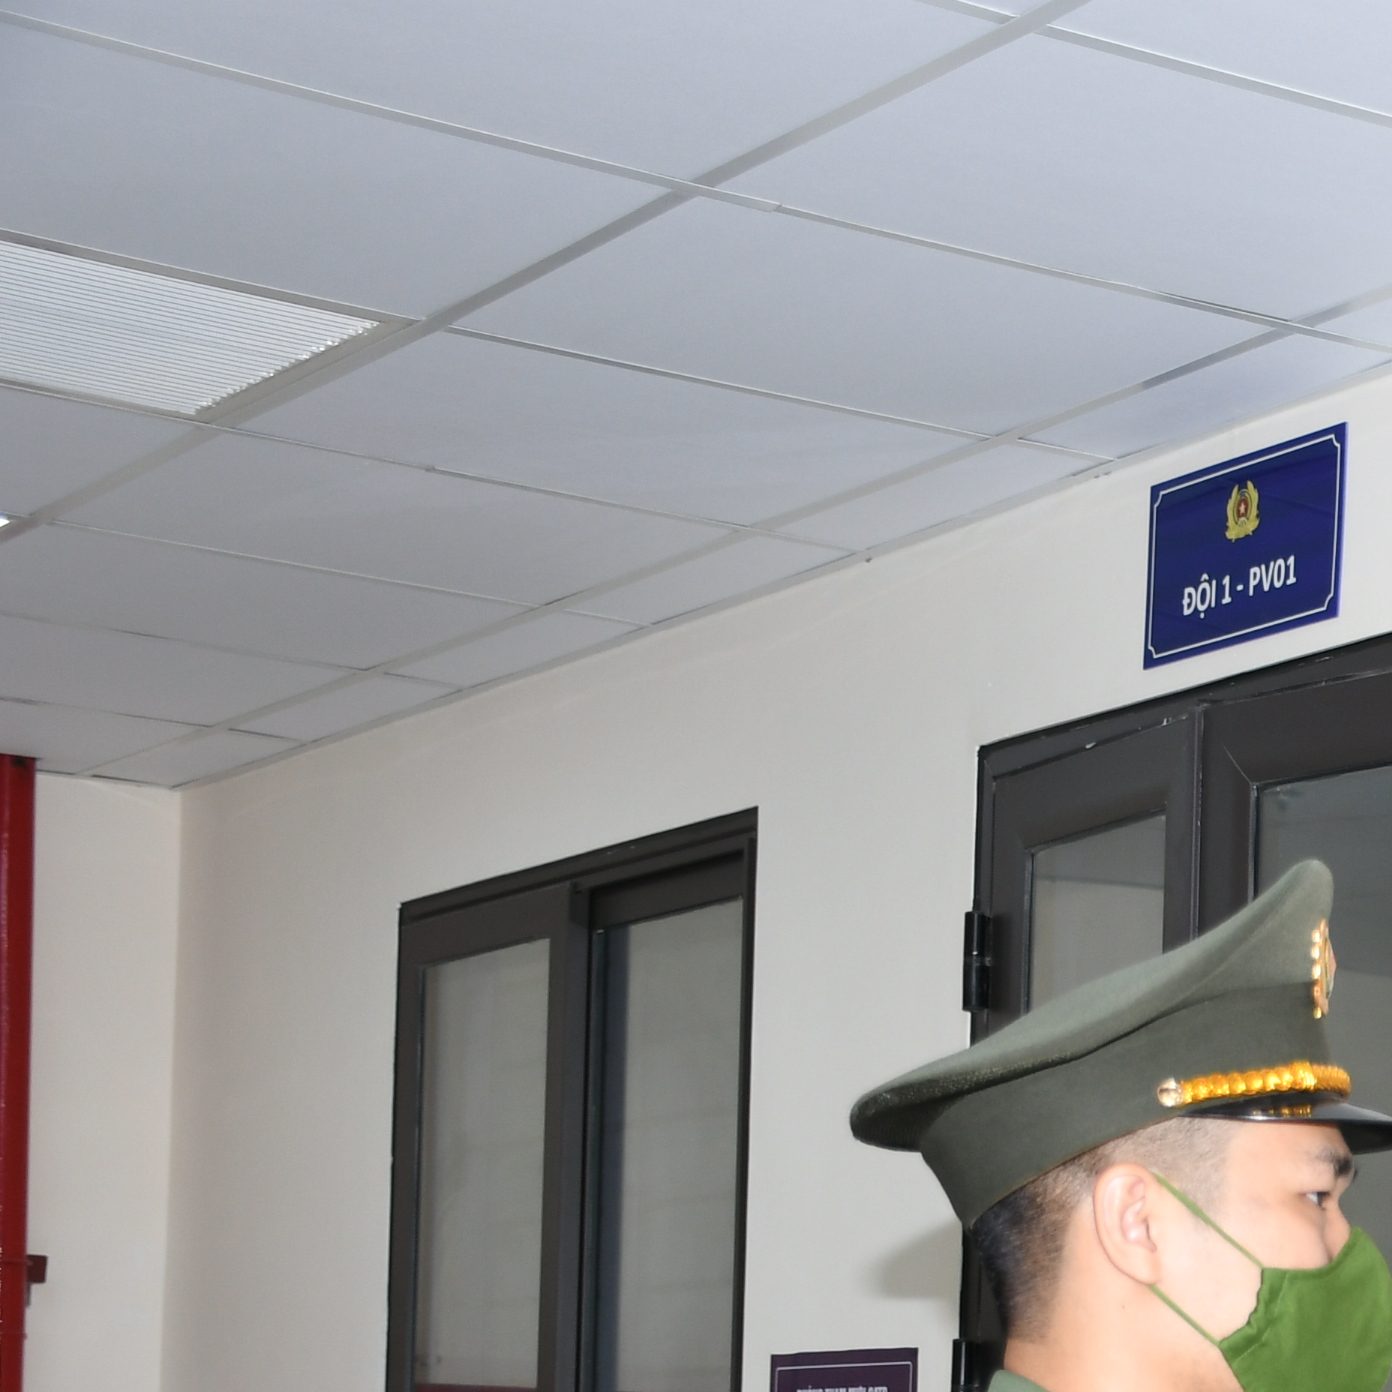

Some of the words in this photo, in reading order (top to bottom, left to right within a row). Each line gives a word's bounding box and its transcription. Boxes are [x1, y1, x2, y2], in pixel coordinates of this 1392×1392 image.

[1182, 573, 1216, 618] ĐỘI
[1221, 575, 1232, 604] 1
[1249, 555, 1297, 596] PV01
